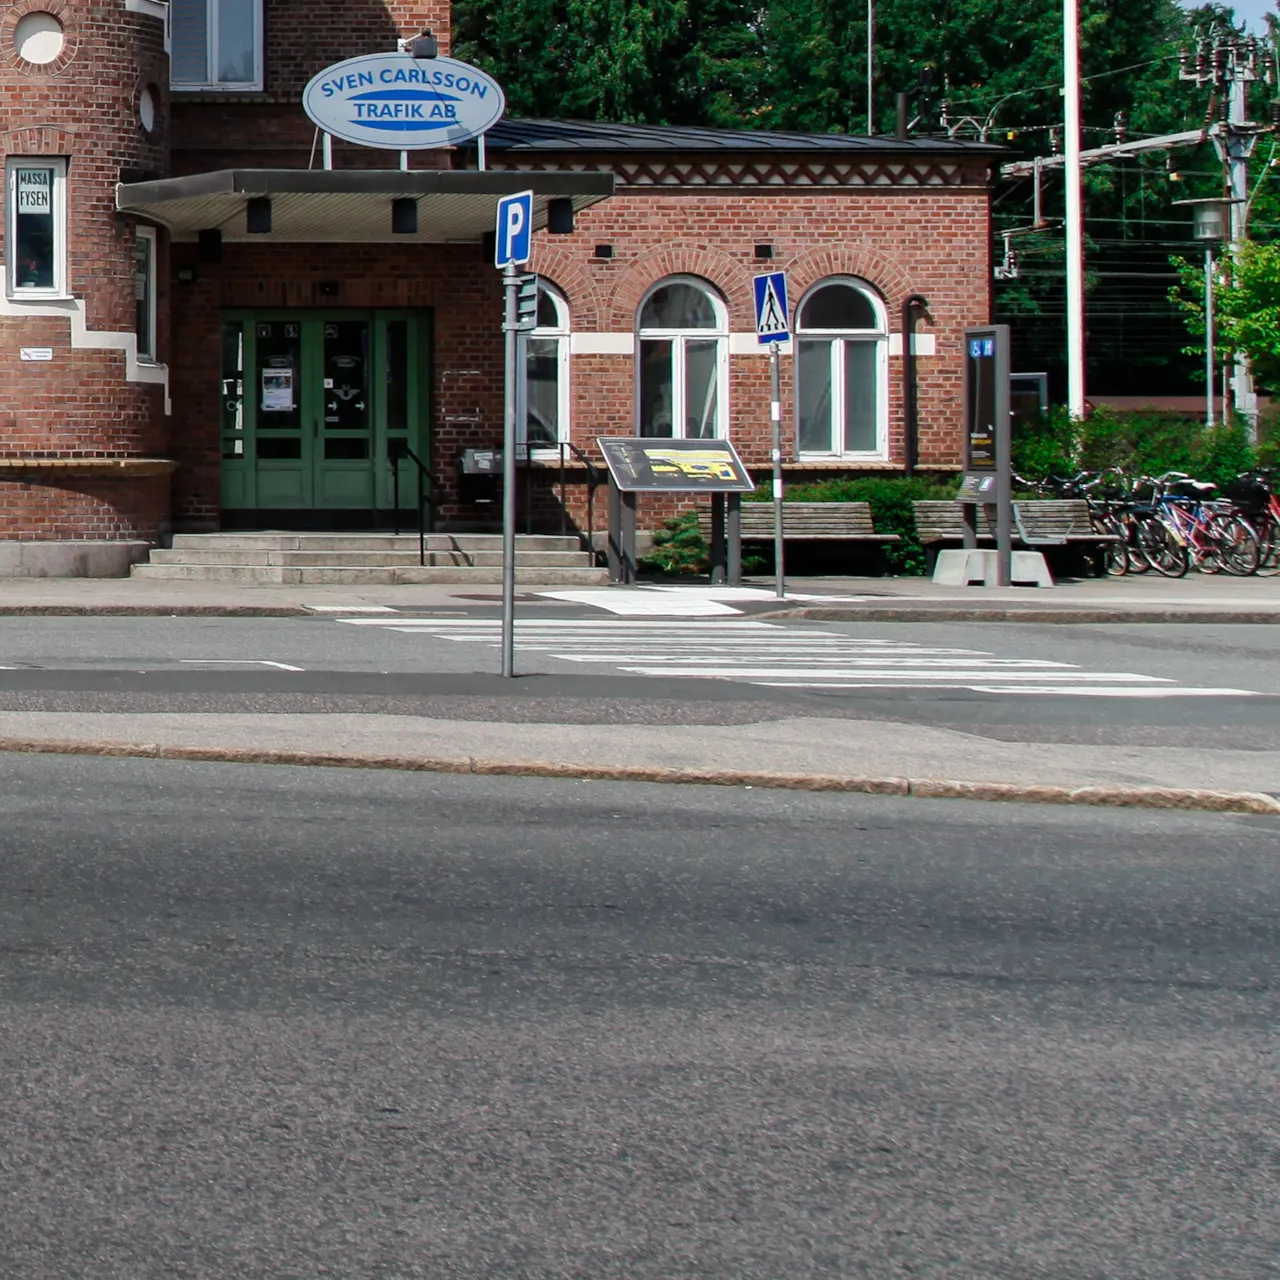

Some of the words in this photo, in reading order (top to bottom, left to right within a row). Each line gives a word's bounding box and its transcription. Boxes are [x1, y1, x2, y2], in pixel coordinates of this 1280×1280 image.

[321, 71, 373, 97] SVEN
[379, 69, 488, 99] CARLSSON
[353, 104, 425, 118] TRAFIK
[429, 104, 457, 118] AB
[20, 172, 48, 185] MASSA
[20, 191, 48, 206] FYSEN
[505, 202, 524, 259] P
